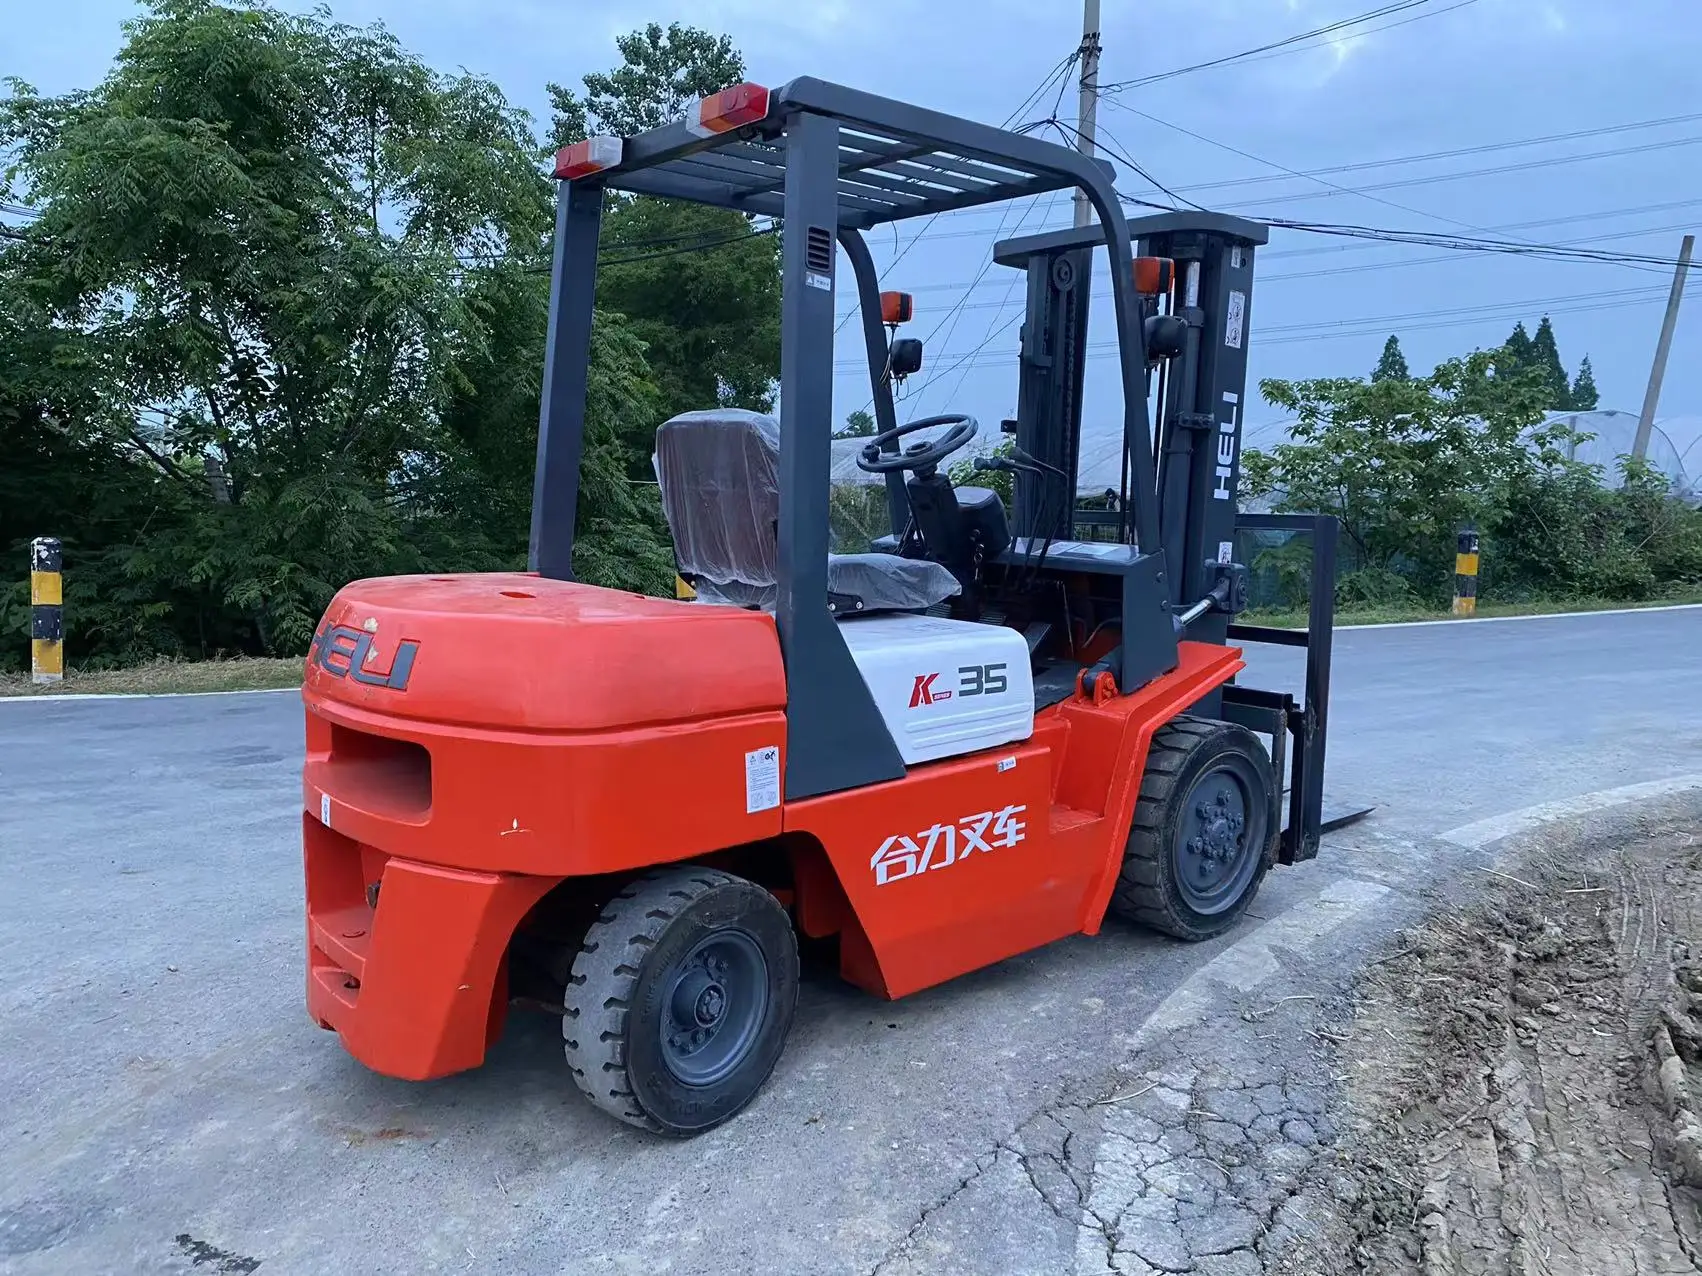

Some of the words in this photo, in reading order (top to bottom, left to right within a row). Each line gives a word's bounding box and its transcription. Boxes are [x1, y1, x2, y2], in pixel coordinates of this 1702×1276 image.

[1214, 391, 1238, 500] HELI
[909, 673, 940, 709] K
[958, 663, 1007, 697] 35
[871, 805, 1026, 886] 合力叉车
